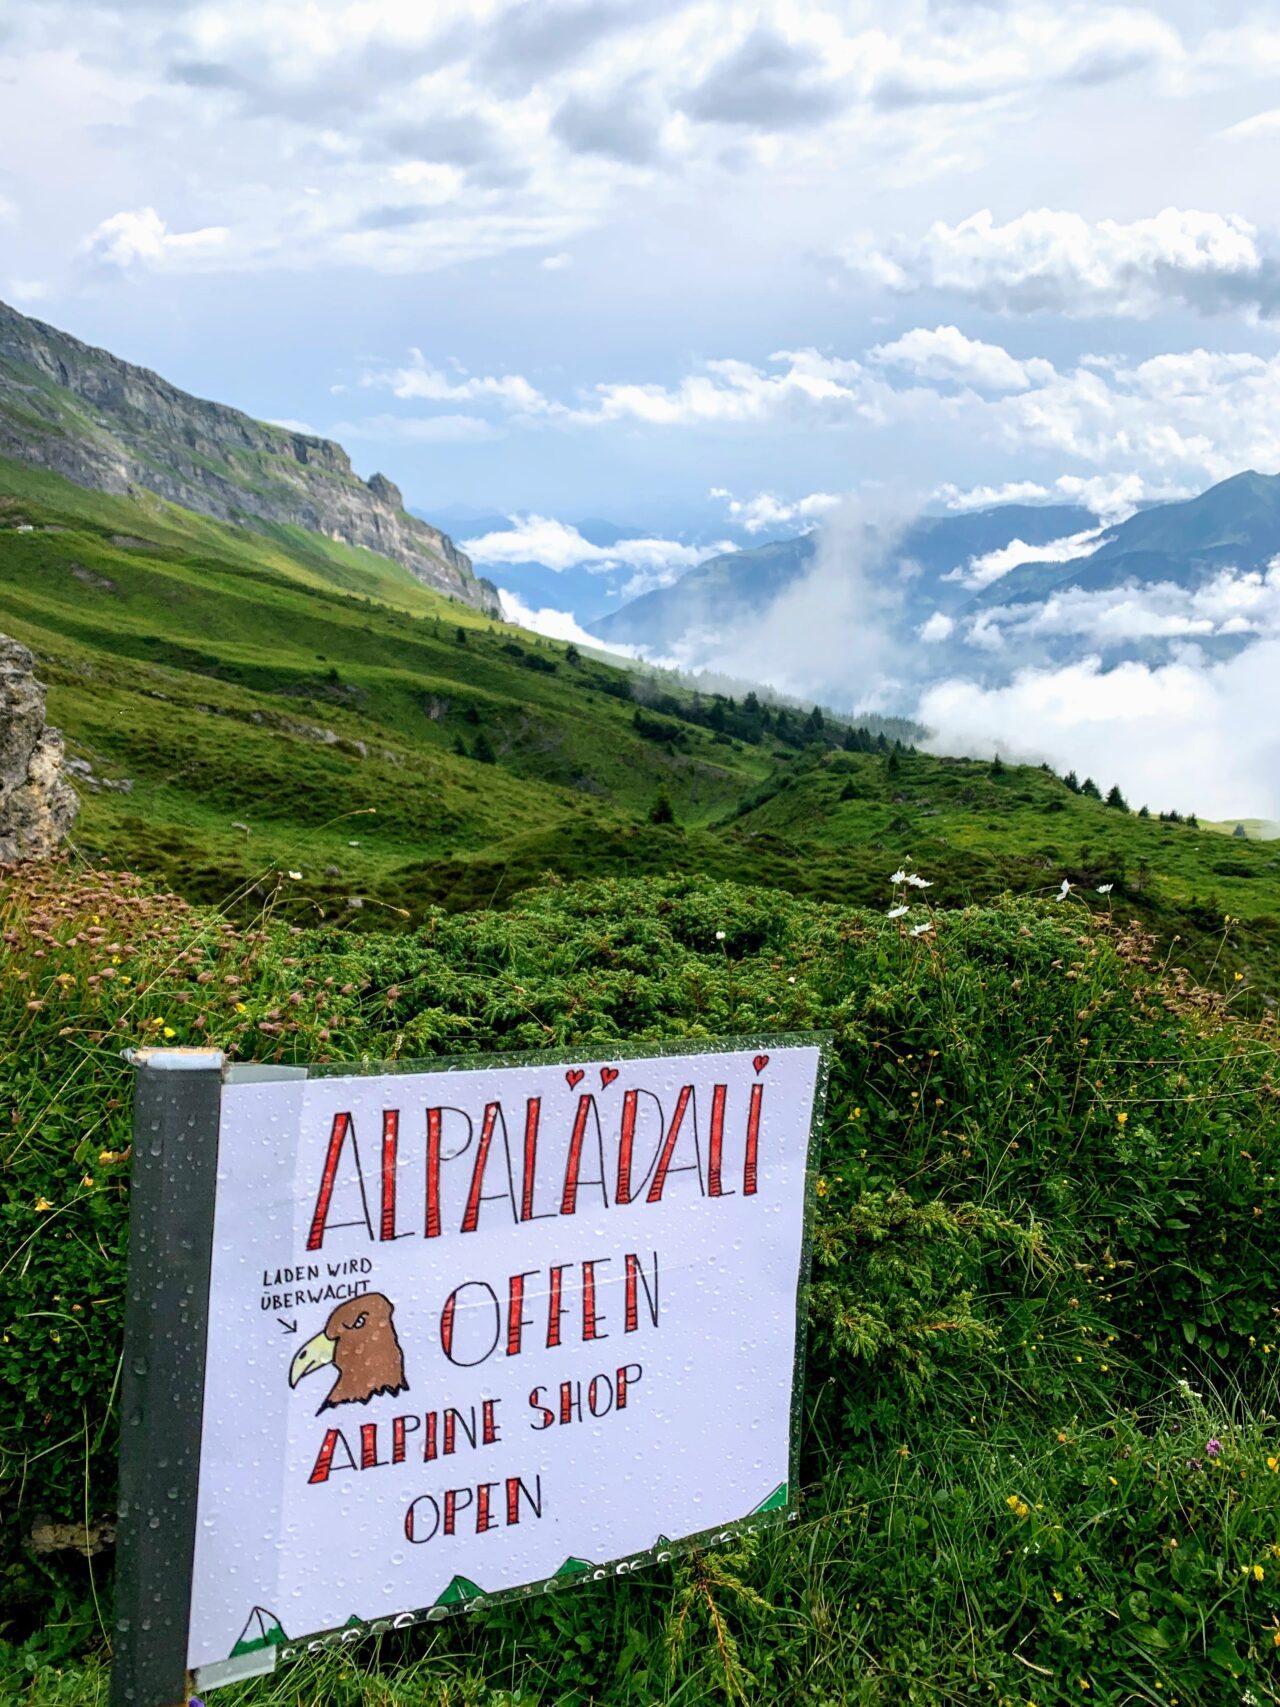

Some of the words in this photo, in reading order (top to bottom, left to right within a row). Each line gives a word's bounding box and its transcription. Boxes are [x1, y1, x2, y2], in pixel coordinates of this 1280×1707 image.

[260, 1279, 371, 1311] ÜBERWACHT
[262, 1264, 320, 1287] LADEN
[326, 1257, 373, 1278] WIRD
[439, 1250, 660, 1368] OFFEN
[306, 1397, 503, 1485] ALPINE
[528, 1362, 644, 1432] SHOP
[403, 1473, 543, 1544] OPEN
